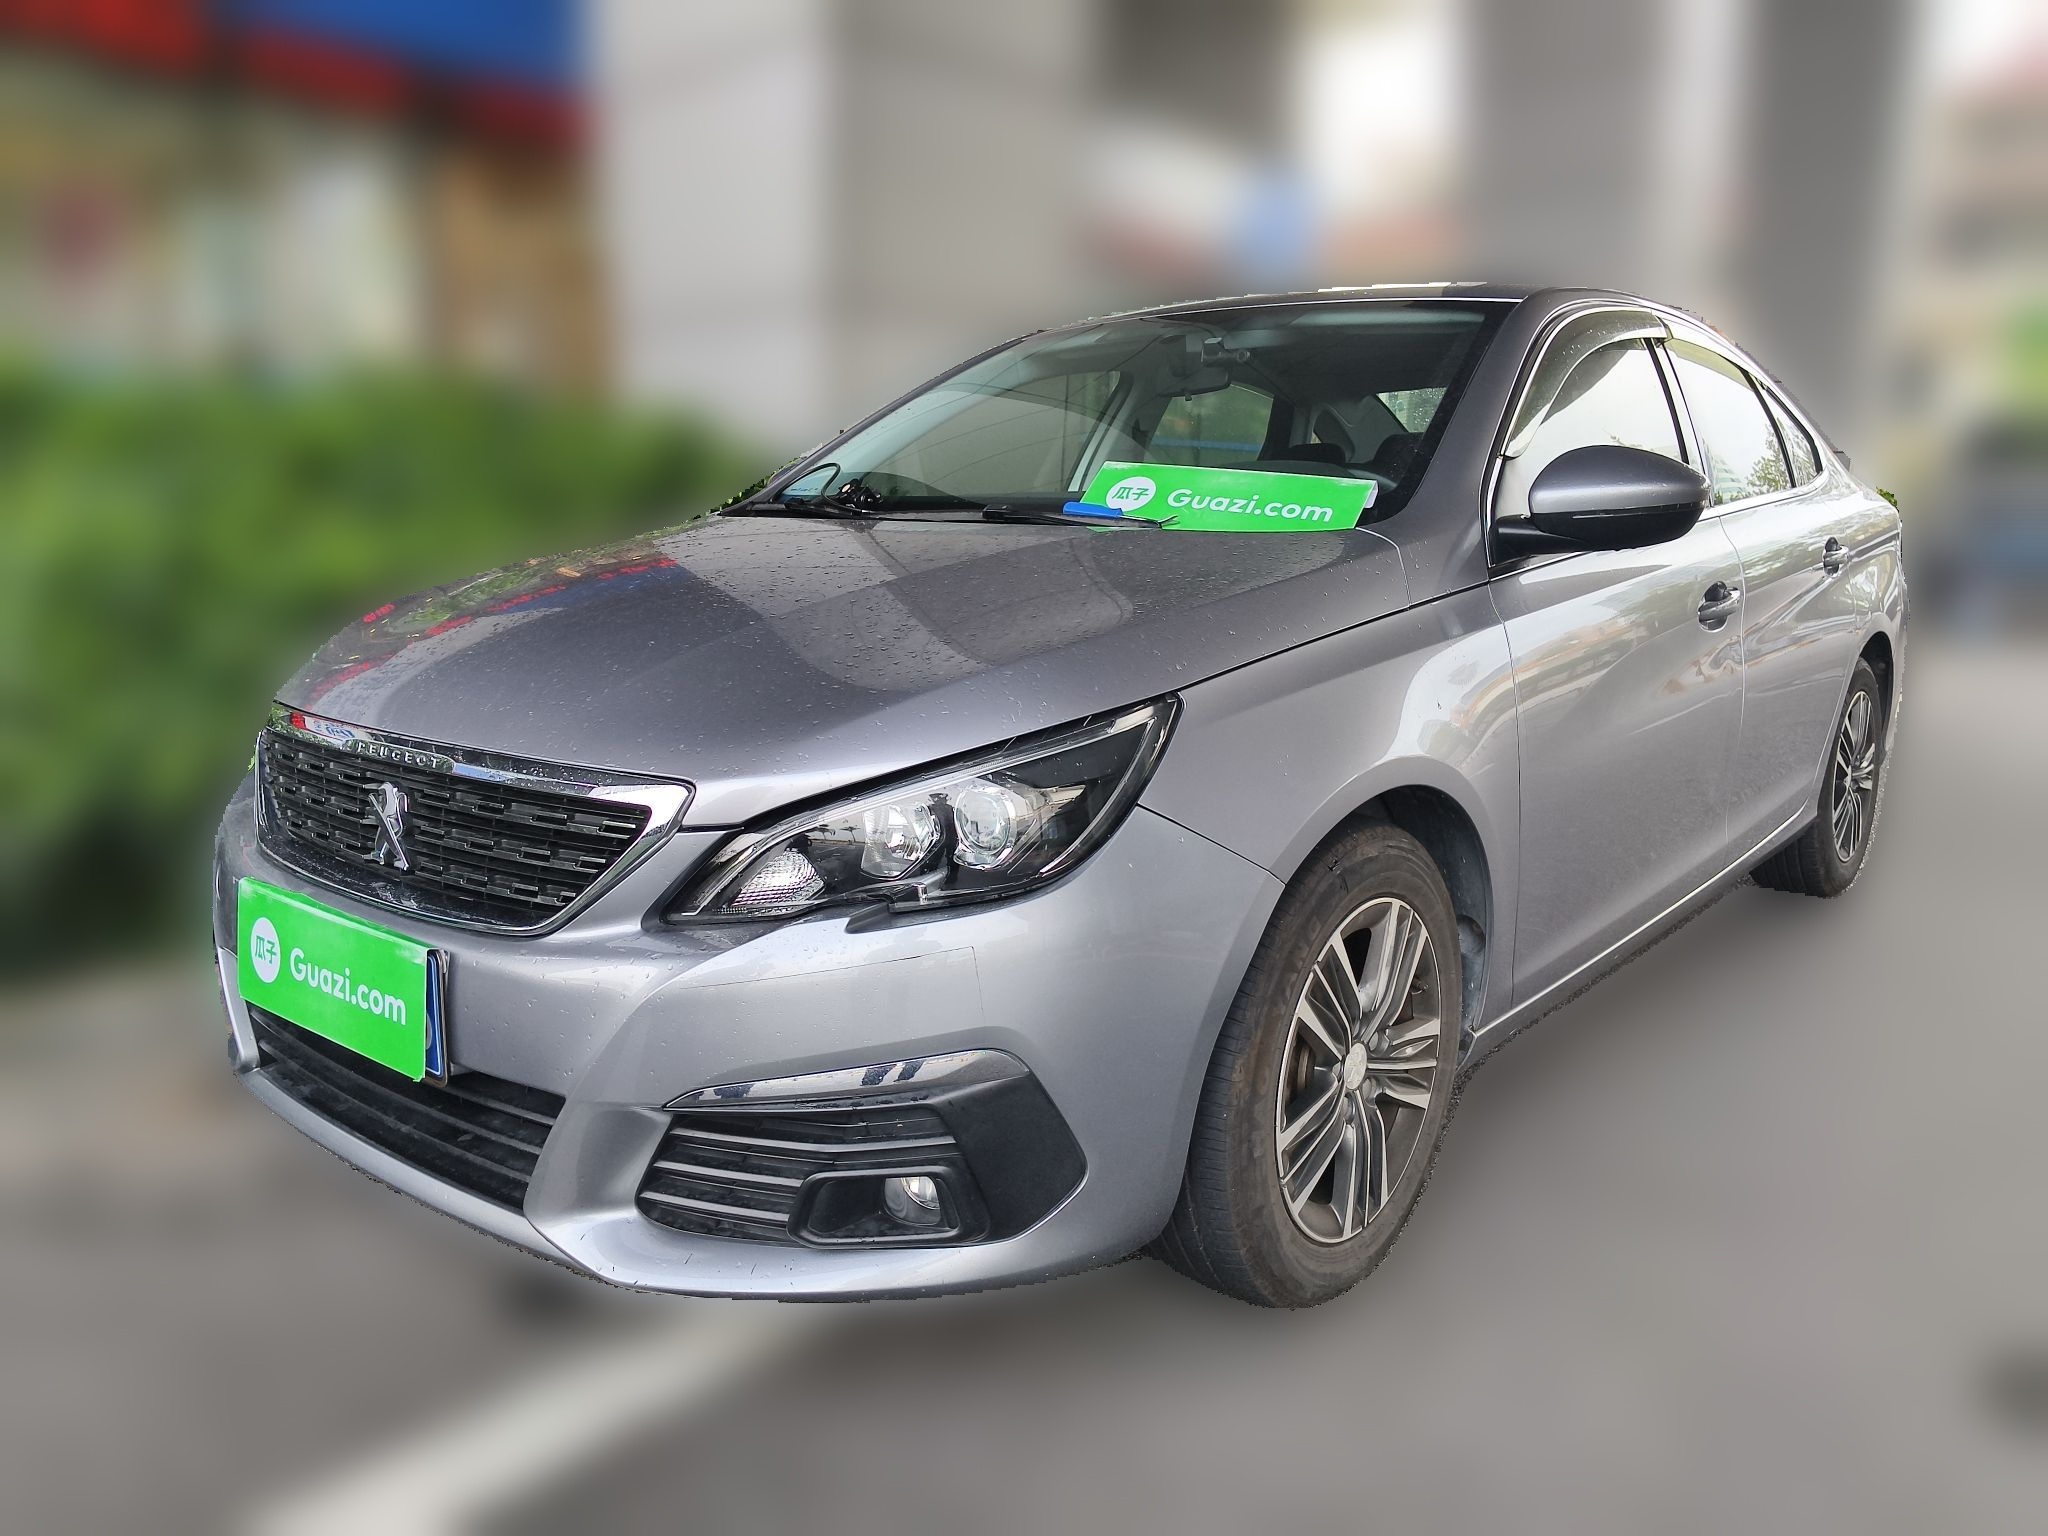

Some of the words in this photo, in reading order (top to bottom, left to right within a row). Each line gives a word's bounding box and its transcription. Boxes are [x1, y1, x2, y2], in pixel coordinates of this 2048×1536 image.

[1112, 486, 1149, 501] 瓜子
[1167, 488, 1333, 522] Guazi.com
[357, 742, 441, 769] PEUGEOT
[255, 935, 277, 964] 瓜子
[289, 947, 406, 1026] Guazi.com
